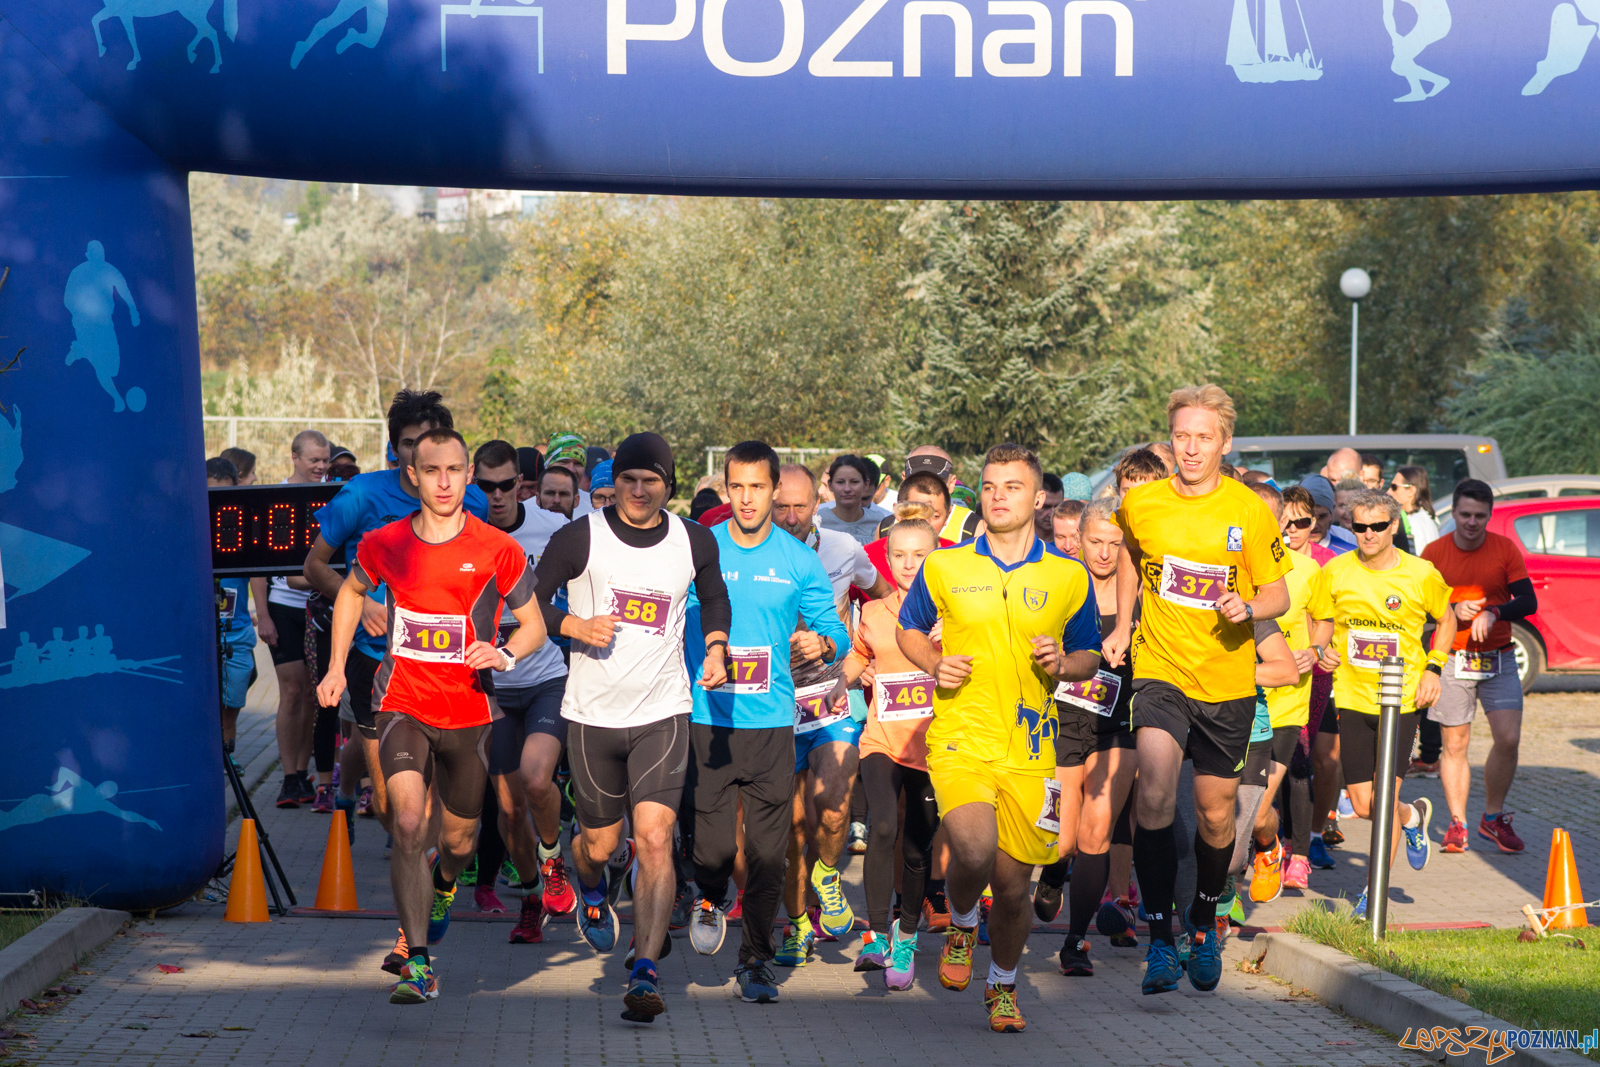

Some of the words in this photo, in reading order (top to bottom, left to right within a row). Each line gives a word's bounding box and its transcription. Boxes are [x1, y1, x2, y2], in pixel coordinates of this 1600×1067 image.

[951, 585, 993, 594] GIVOVA
[1181, 575, 1214, 596] 37
[623, 599, 658, 623] 58
[416, 629, 450, 649] 10
[1362, 643, 1388, 658] 45
[726, 661, 758, 680] 17
[1470, 658, 1492, 671] 85
[896, 686, 927, 706] 46
[1080, 680, 1108, 702] 13
[808, 698, 822, 717] 7
[1055, 797, 1060, 818] 6
